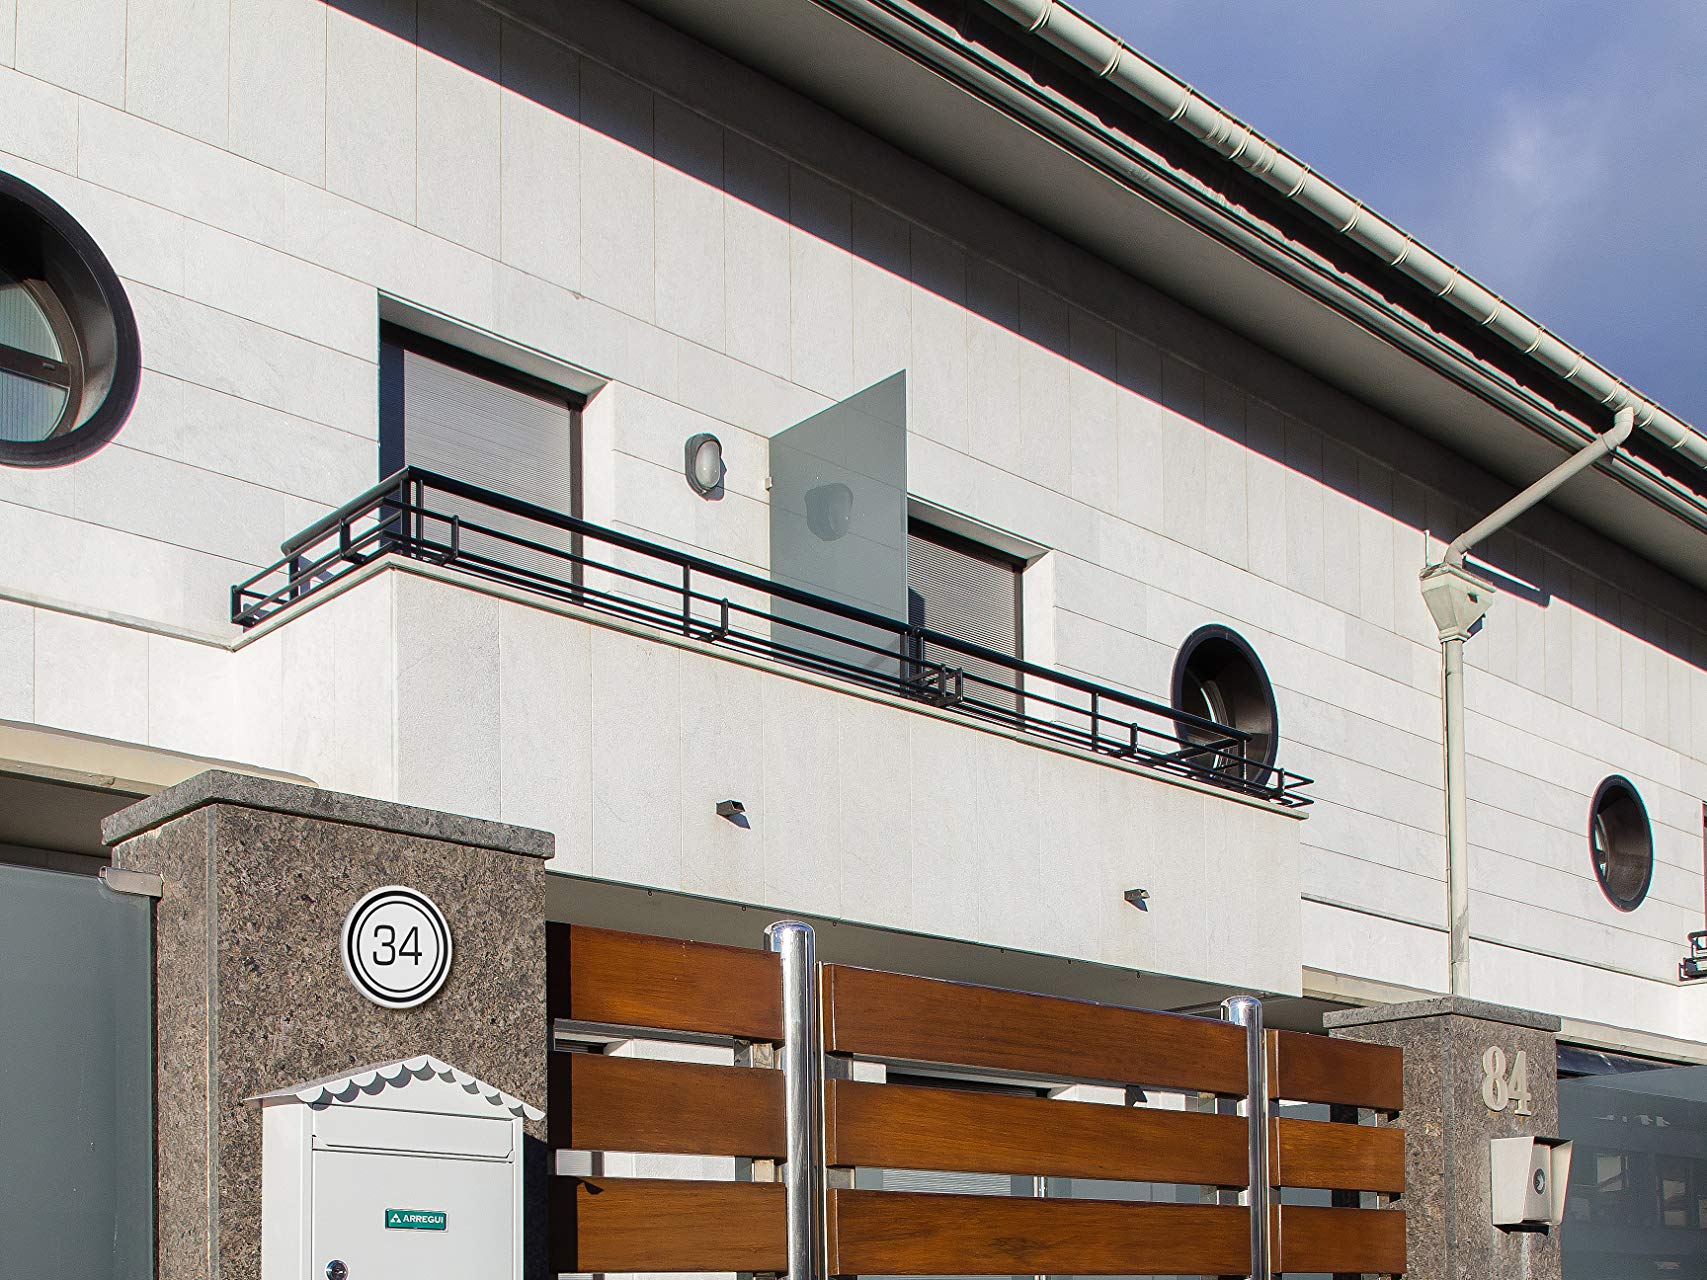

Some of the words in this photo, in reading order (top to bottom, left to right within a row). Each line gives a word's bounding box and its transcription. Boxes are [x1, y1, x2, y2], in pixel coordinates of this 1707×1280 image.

[373, 925, 423, 966] 34
[1482, 1046, 1532, 1116] 84
[402, 1214, 444, 1224] ARREGUI
